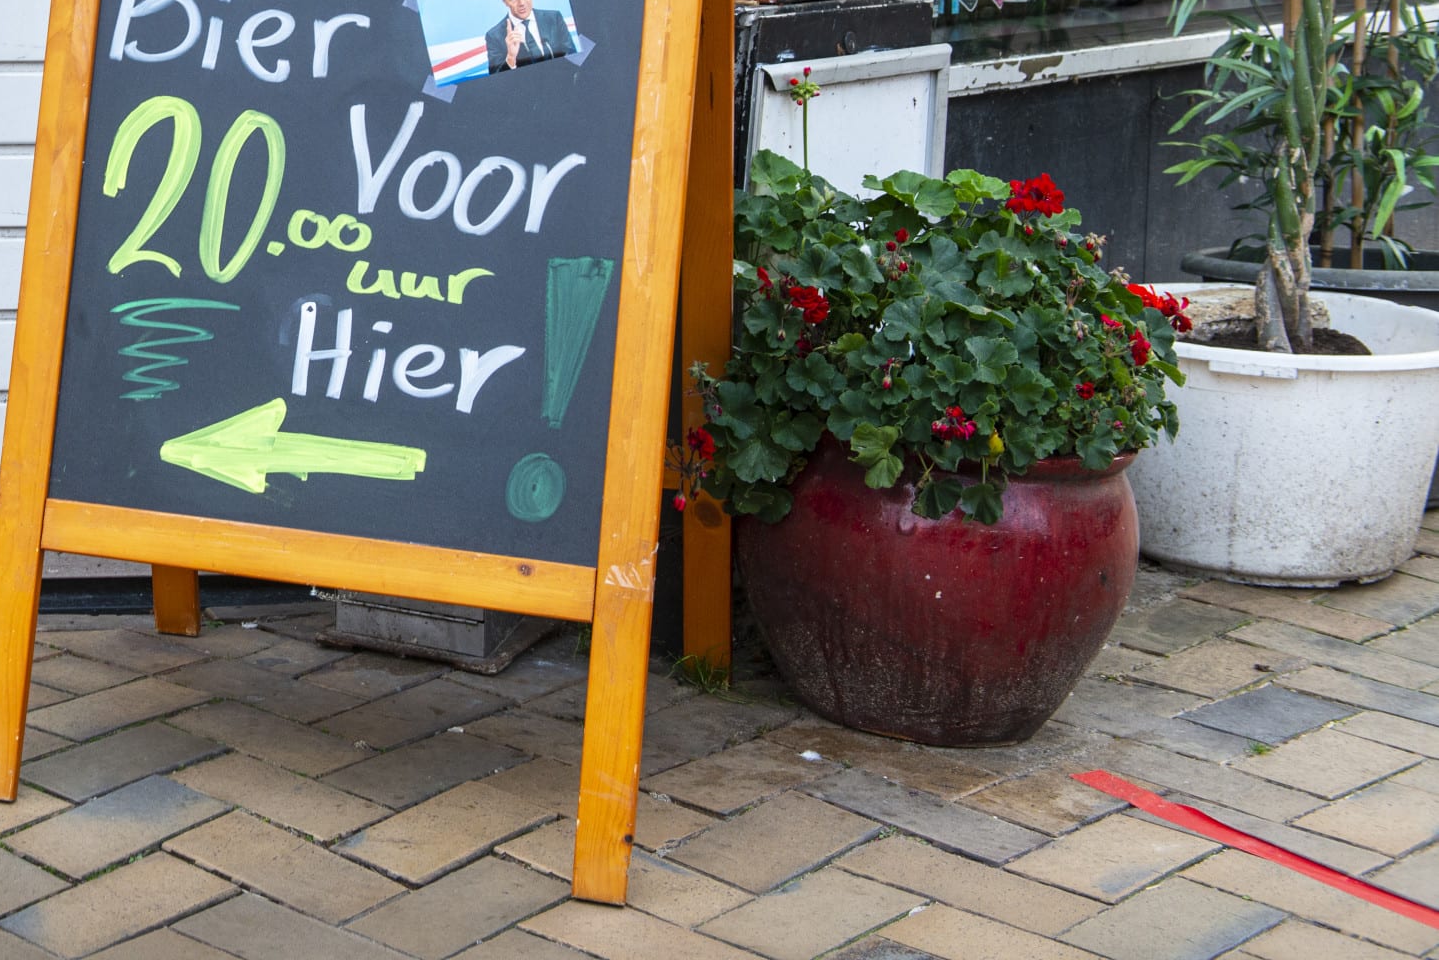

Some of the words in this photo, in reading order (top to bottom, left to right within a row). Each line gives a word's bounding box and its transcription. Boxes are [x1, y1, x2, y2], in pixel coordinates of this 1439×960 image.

[102, 95, 373, 283] 20.00
[349, 101, 586, 235] Voor
[346, 260, 494, 305] uur
[291, 301, 526, 414] Hier
